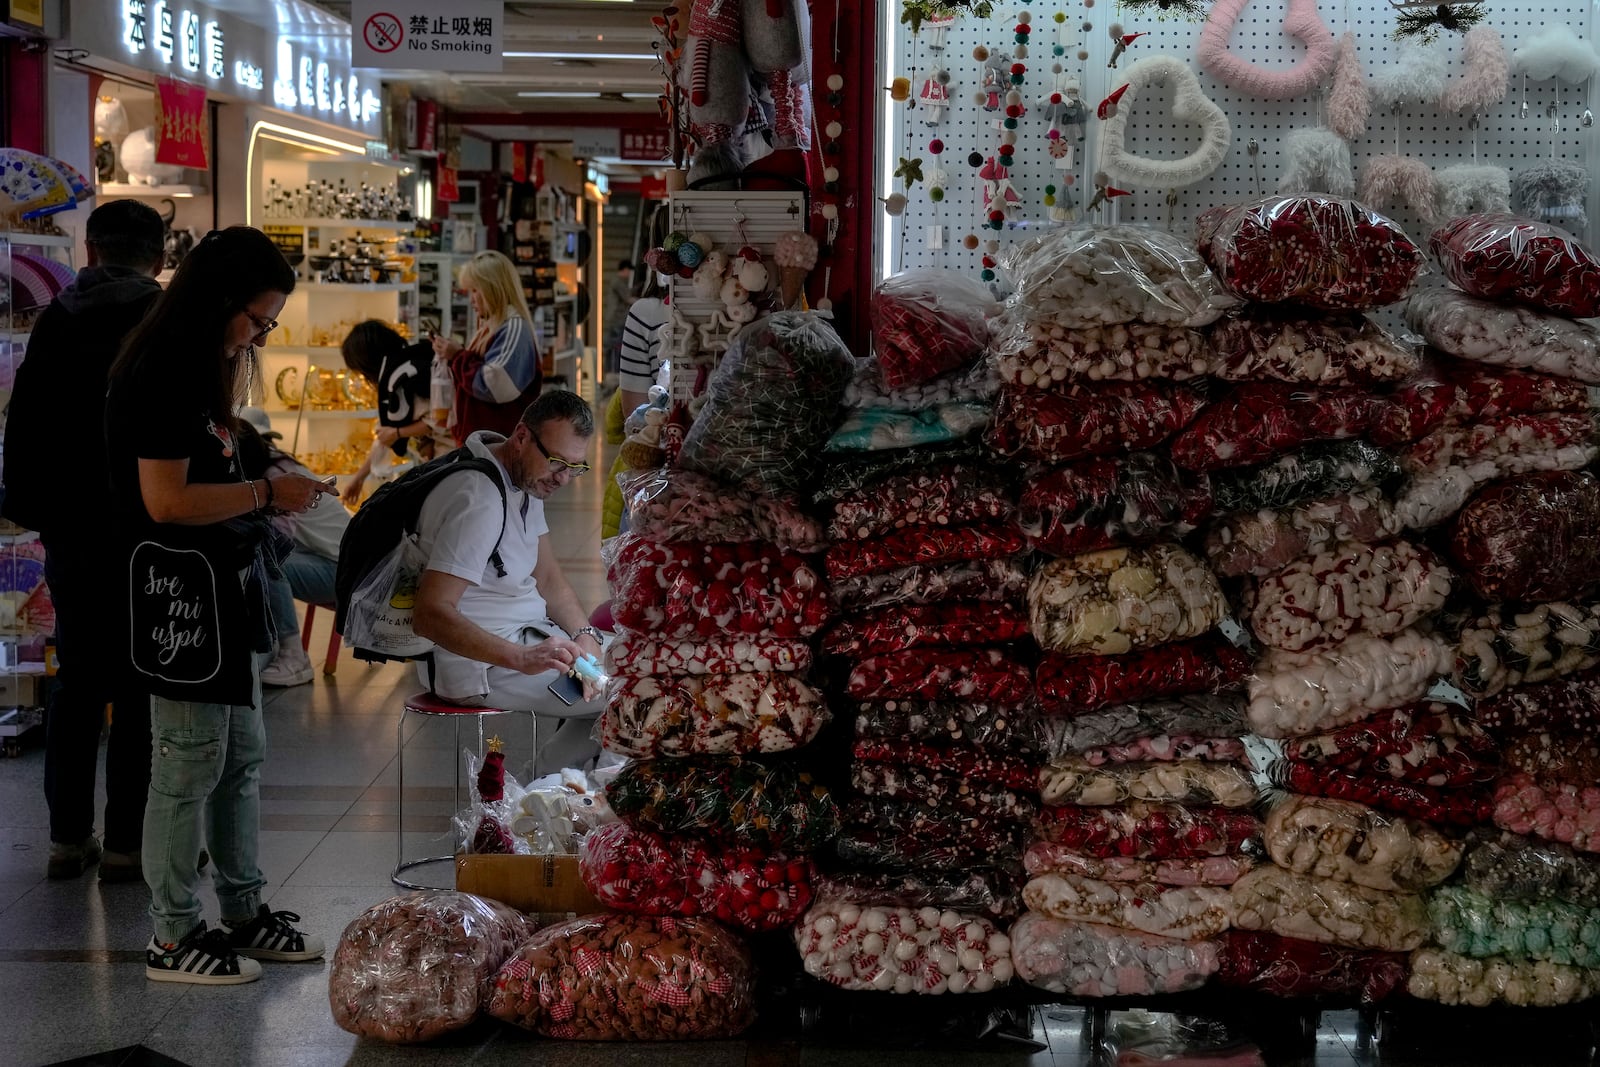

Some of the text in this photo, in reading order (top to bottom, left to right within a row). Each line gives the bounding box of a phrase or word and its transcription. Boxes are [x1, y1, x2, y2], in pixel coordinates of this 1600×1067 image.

[409, 15, 492, 37] 禁止吸烟
[408, 39, 492, 54] No Smoking
[144, 565, 185, 597] Sve
[167, 595, 204, 619] mi
